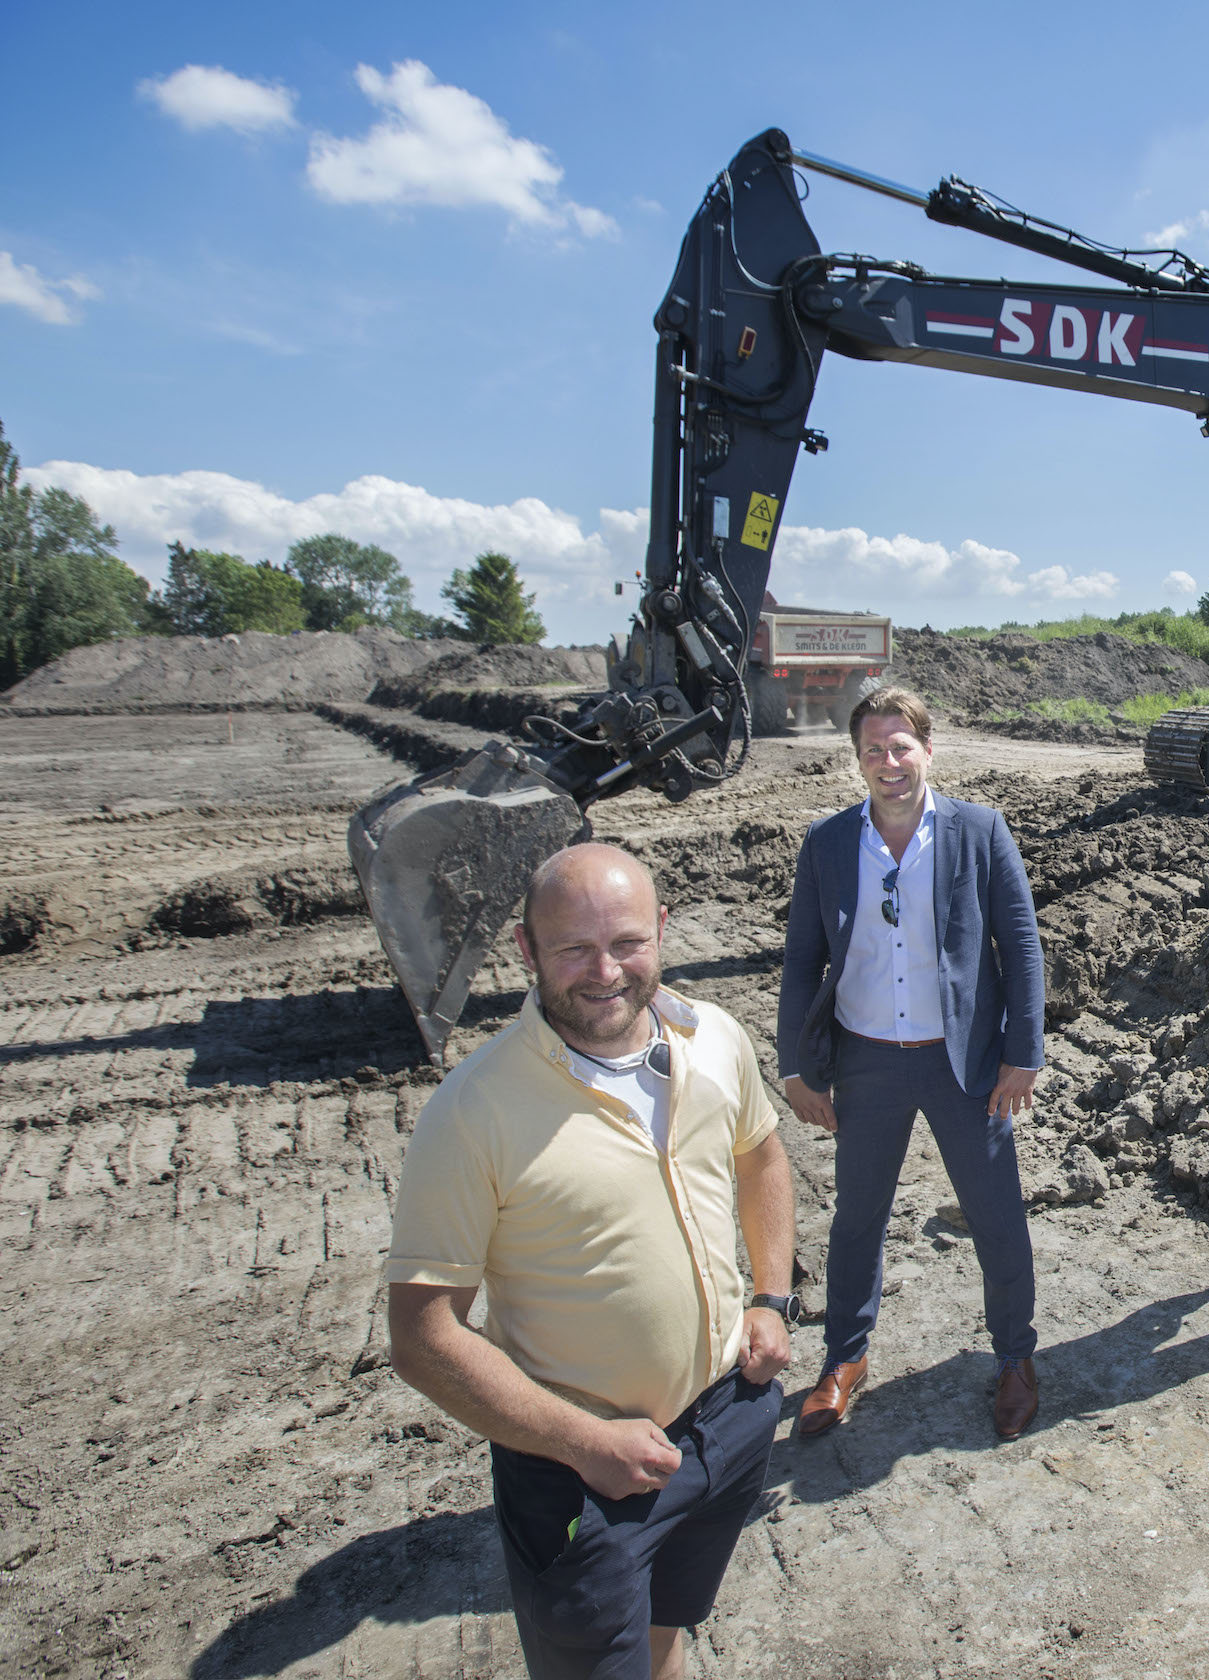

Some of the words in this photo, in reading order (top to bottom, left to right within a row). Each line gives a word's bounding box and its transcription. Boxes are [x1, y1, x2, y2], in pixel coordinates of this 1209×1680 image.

[1000, 298, 1136, 366] SDK
[810, 628, 849, 641] SDK
[795, 642, 821, 651] SMITS
[822, 642, 828, 651] &
[829, 642, 840, 651] DE
